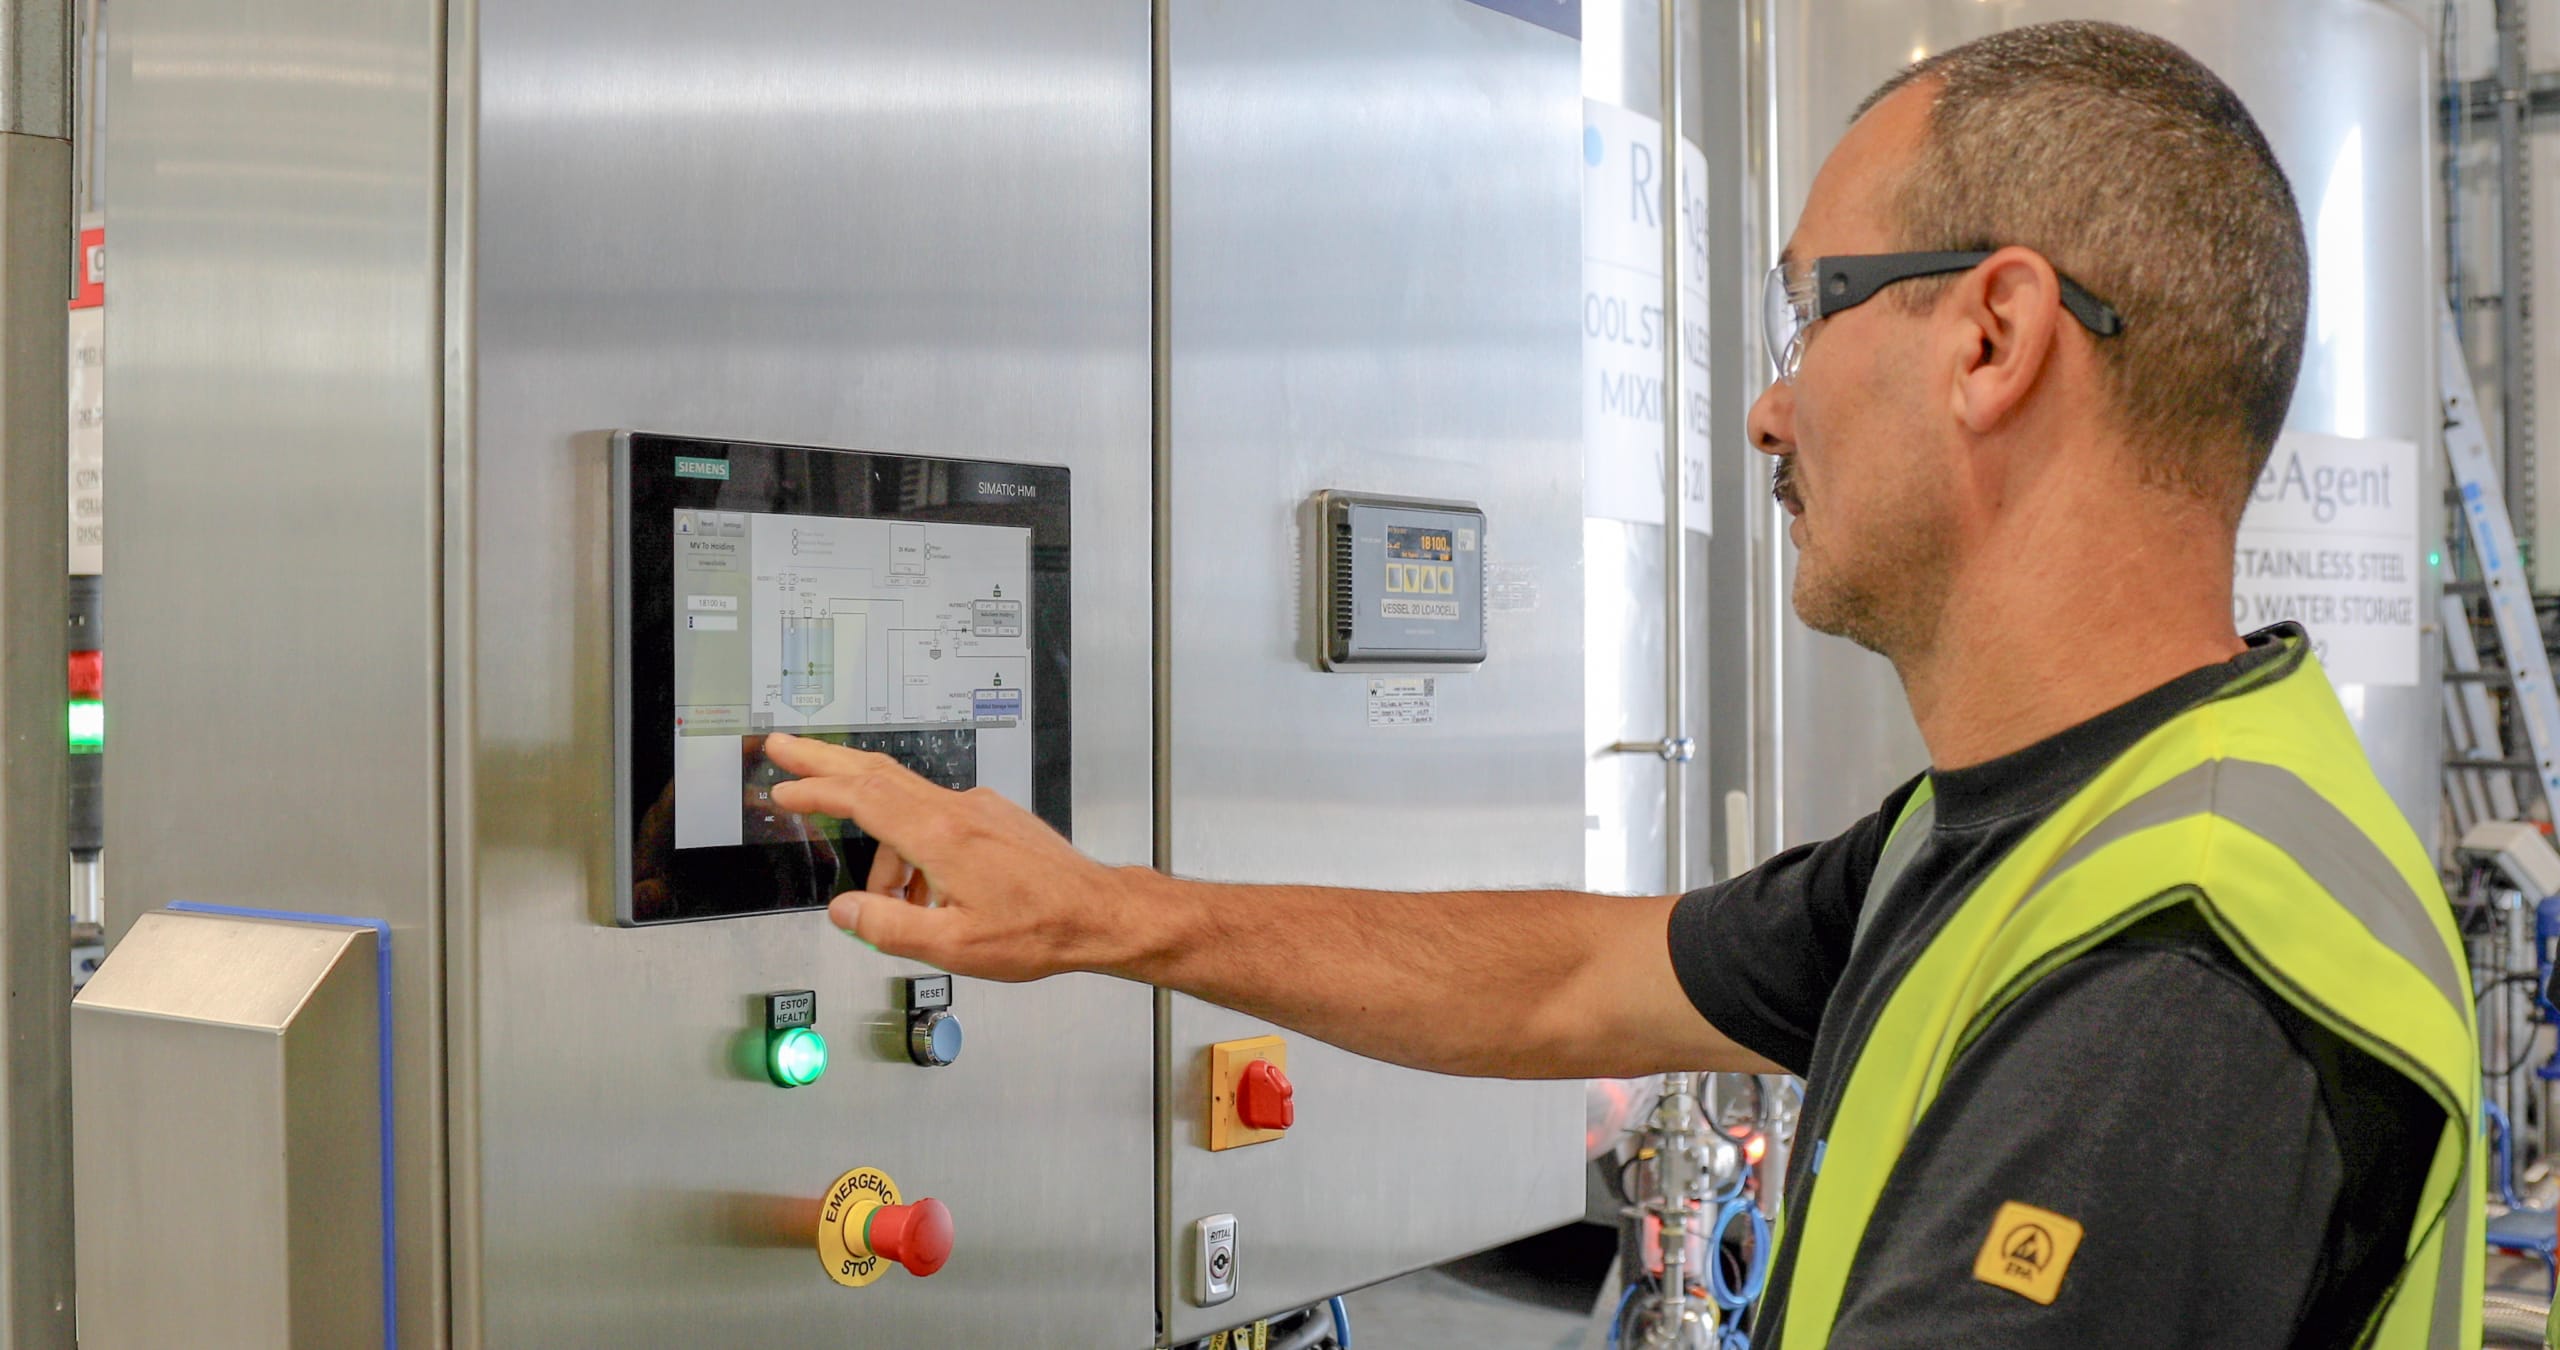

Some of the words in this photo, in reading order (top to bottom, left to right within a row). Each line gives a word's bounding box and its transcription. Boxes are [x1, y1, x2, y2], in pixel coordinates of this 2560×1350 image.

[679, 461, 726, 475] SIEMENS
[978, 481, 1016, 496] SIMATIC
[1017, 484, 1036, 497] HMI
[2252, 451, 2392, 524] eAgent
[690, 541, 700, 550] MV
[702, 542, 709, 550] To
[711, 543, 735, 552] Holding
[1422, 535, 1447, 551] 18100
[699, 600, 719, 608] 18100
[1383, 603, 1410, 615] VESSEL
[1412, 604, 1421, 616] 20
[1422, 604, 1457, 616] LOADCELL
[2254, 595, 2337, 624] WATER
[2342, 597, 2414, 626] STORAGE
[920, 988, 945, 999] RESET
[780, 998, 809, 1011] ESTOP
[776, 1011, 809, 1024] HEALTY
[826, 1173, 896, 1223] EMERGENC
[1210, 1228, 1232, 1242] RITTAL
[841, 1255, 877, 1277] STOP
